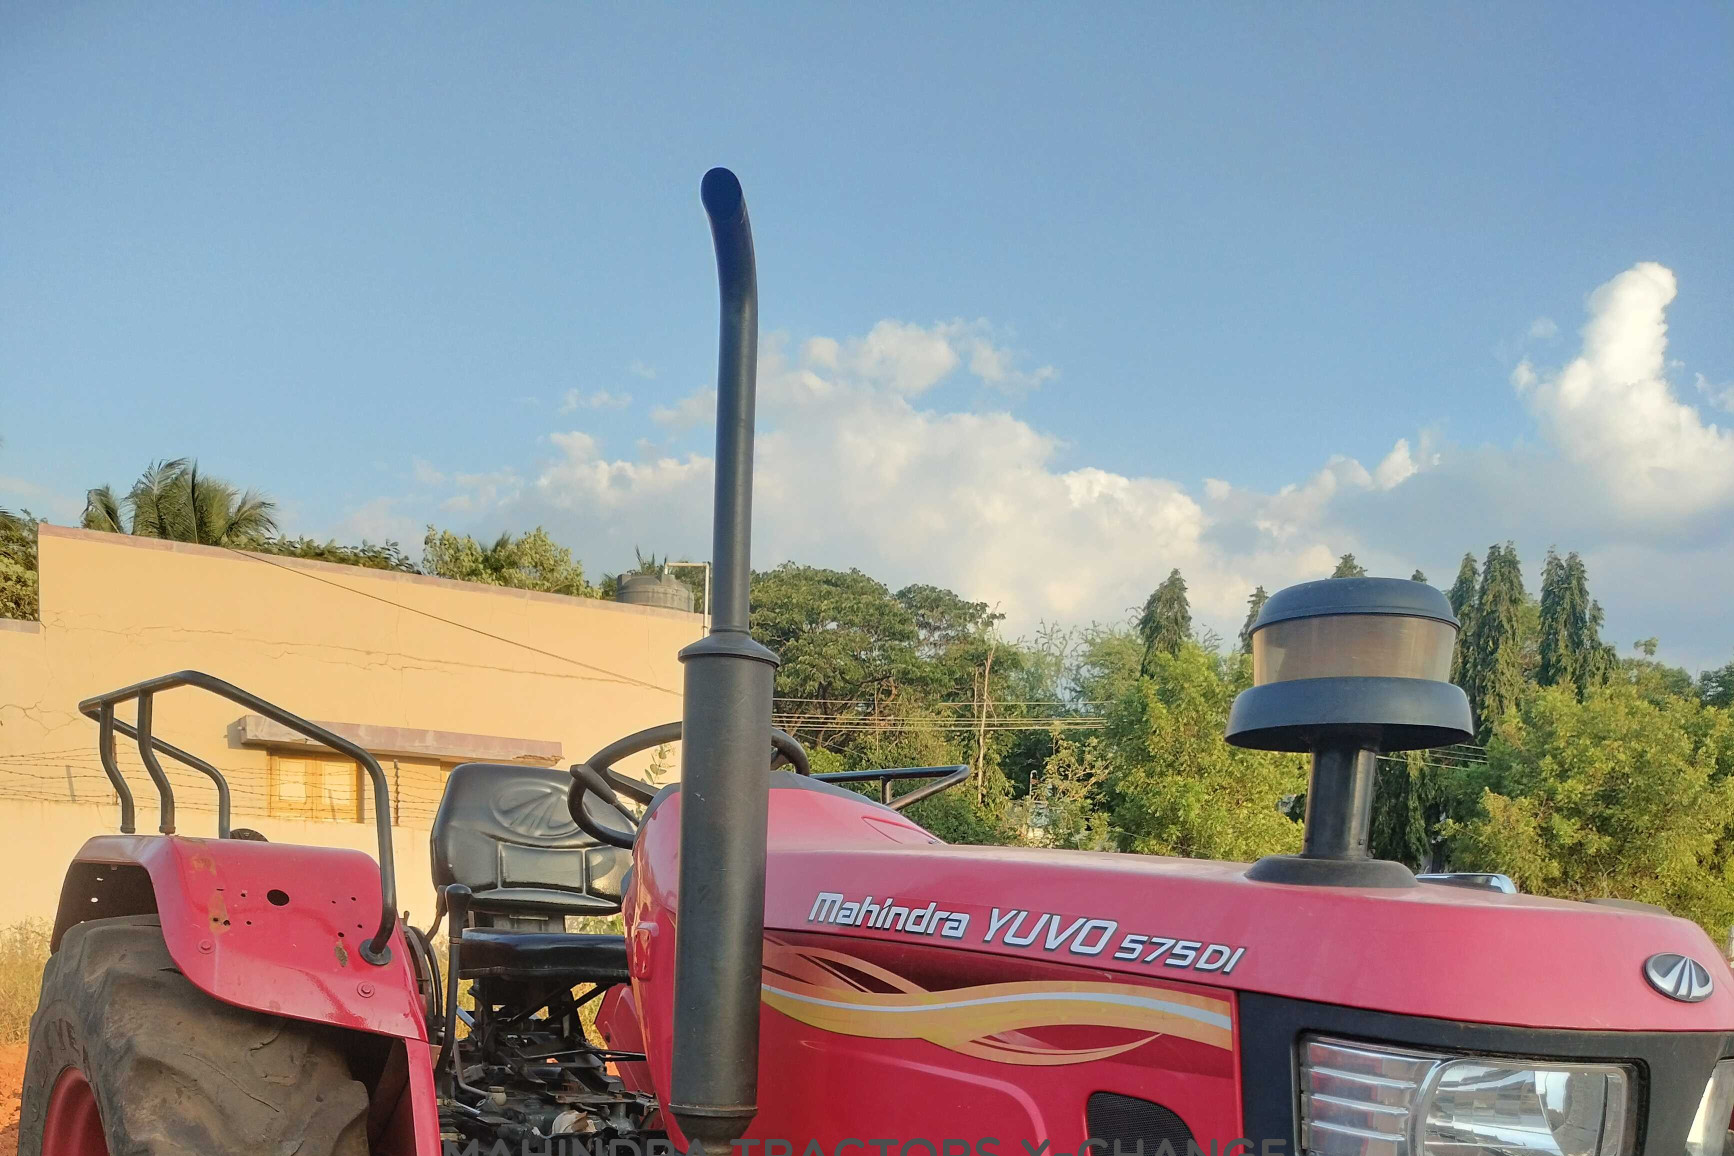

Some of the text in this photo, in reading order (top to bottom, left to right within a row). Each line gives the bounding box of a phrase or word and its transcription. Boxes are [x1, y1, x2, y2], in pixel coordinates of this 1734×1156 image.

[808, 892, 1245, 974] Mahindra YUVO 575DI
